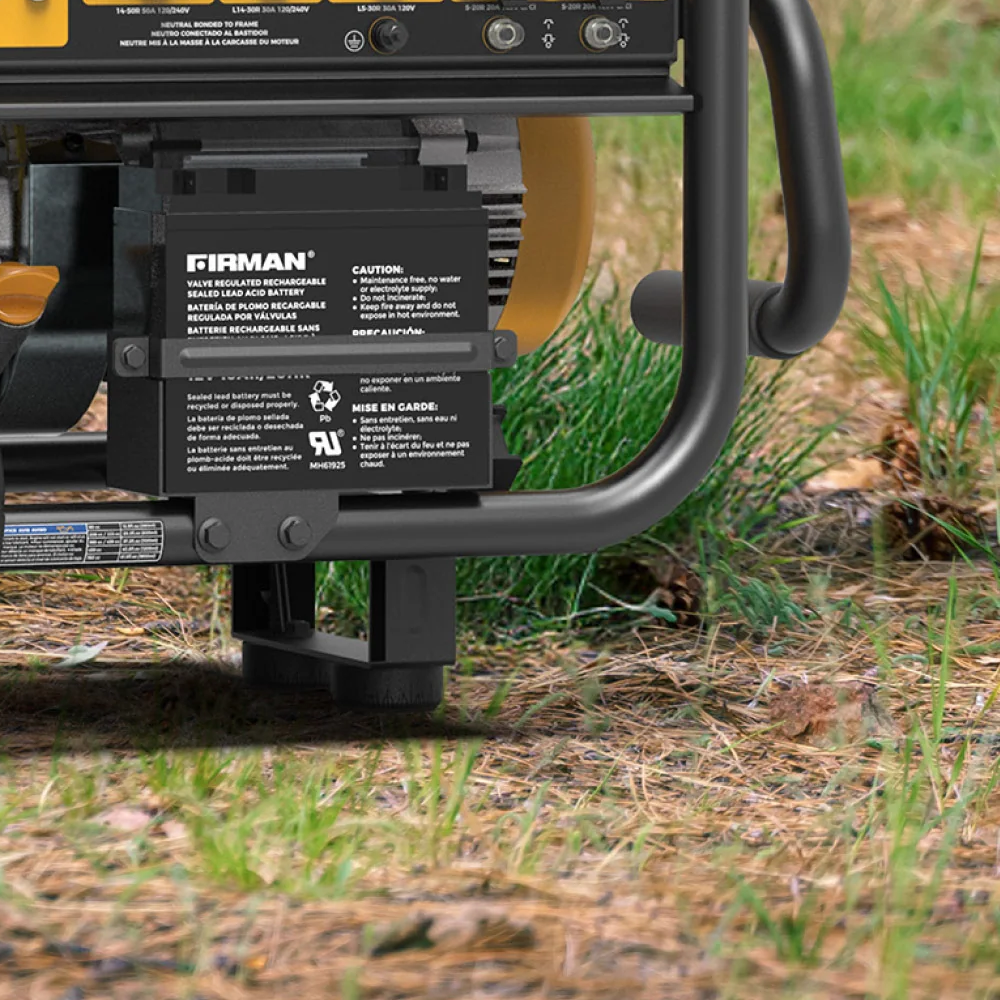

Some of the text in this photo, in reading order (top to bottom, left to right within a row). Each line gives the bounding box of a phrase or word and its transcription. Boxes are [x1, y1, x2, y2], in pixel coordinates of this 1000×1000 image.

[151, 30, 180, 38] NEUTRO
[234, 29, 268, 37] BASTIDOR
[221, 38, 258, 46] CARCASSE
[352, 265, 404, 275] CAUTION:
[187, 278, 327, 288] VALVE REGULATED RECHARGEABLE
[360, 276, 408, 284] Maintenance
[440, 275, 461, 283] water
[187, 288, 305, 298] SEALED LEAD ACID BATTERY
[370, 284, 410, 294] electrolyte
[225, 303, 236, 311] DE
[238, 302, 269, 310] PLOMO
[271, 301, 327, 310] RECARGABLE
[360, 301, 456, 311] Keep fire away and do not
[187, 311, 298, 322] REGULADA POR VÁLVULAS
[360, 312, 387, 321] expose
[411, 310, 460, 318] environment.
[187, 324, 320, 335] BATTERIE RECHARGEABLE SANS
[187, 393, 212, 401] Sealed
[232, 392, 260, 401] battery
[187, 402, 219, 411] recycled
[230, 402, 264, 411] disposed
[352, 402, 438, 412] MISE EN GARDE:
[319, 414, 332, 423] Pb
[360, 416, 378, 424] Sans
[450, 414, 458, 422] ni
[360, 442, 379, 450] Tenir
[410, 441, 421, 449] du
[422, 441, 435, 449] feu
[436, 441, 444, 449] et
[456, 442, 470, 450] pas
[187, 455, 235, 464] plomb-acide
[236, 455, 252, 463] doit
[360, 452, 390, 460] exposer
[409, 450, 464, 458] environnement
[360, 460, 385, 468] chaud.
